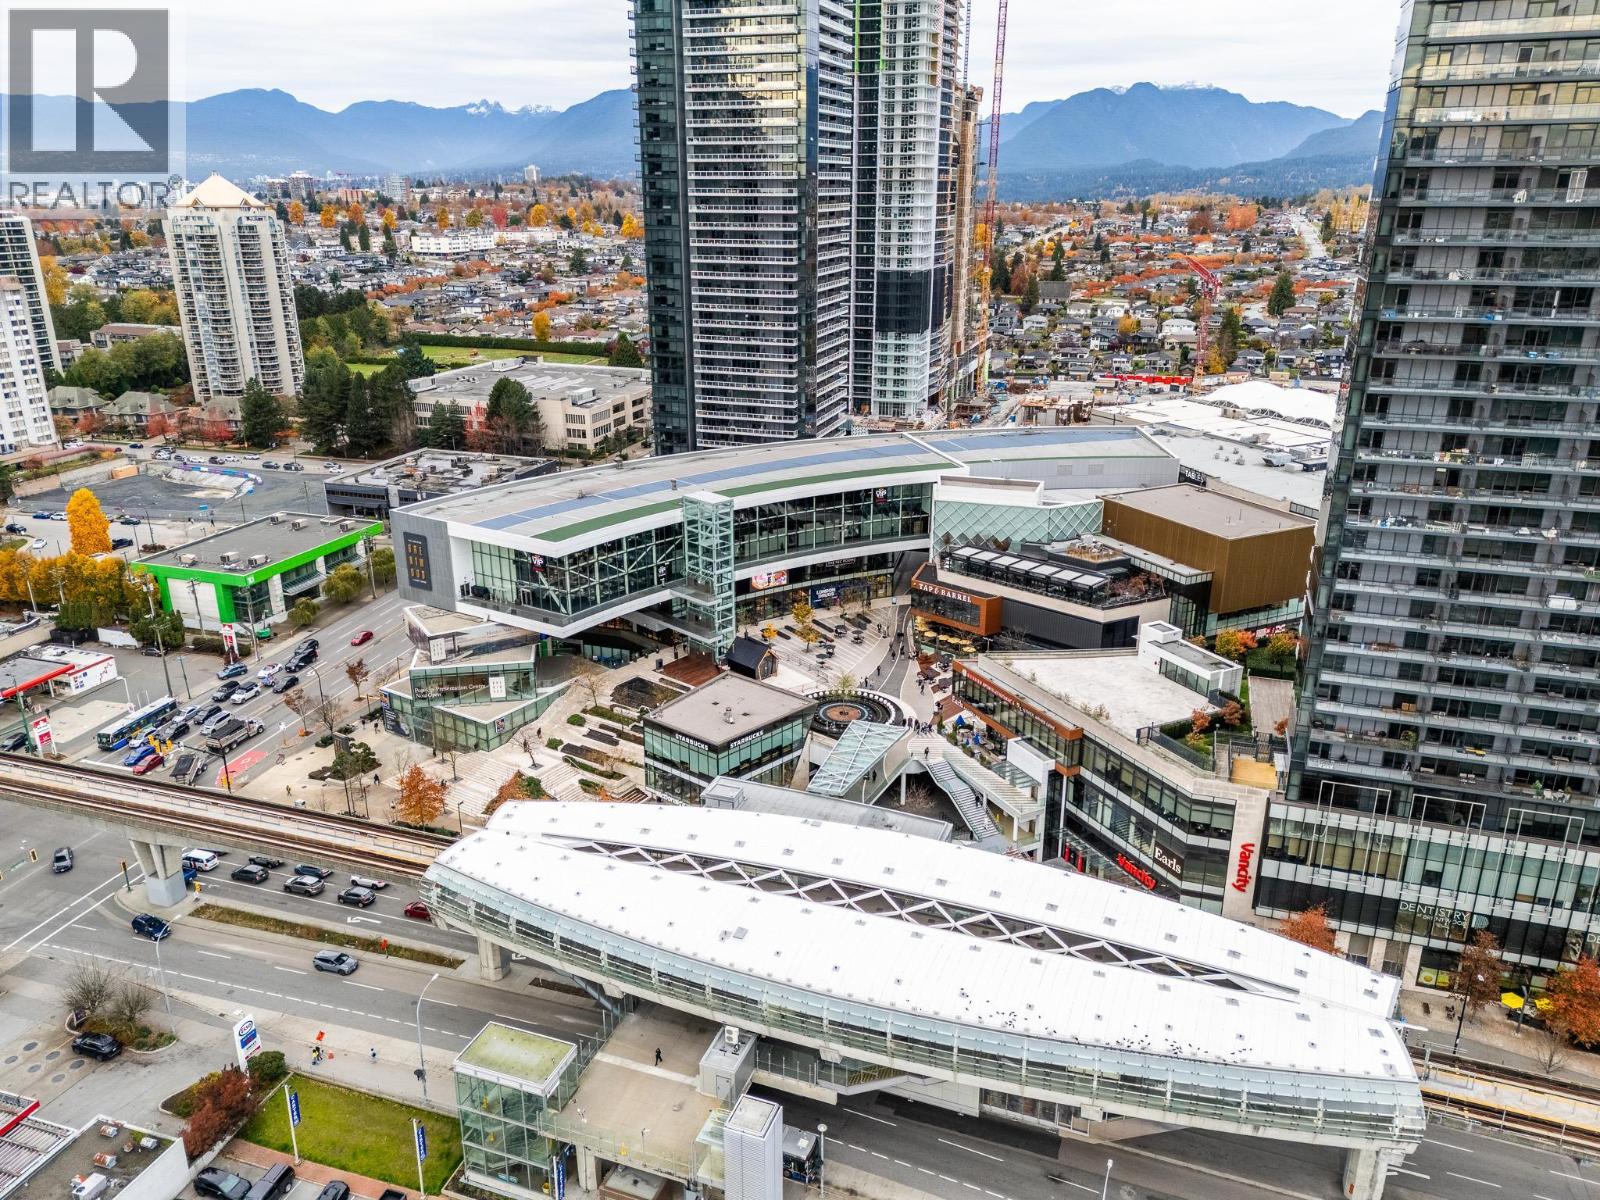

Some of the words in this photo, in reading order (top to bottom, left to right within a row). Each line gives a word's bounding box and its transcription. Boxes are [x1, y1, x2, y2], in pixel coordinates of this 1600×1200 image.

[919, 583, 934, 593] TAP
[941, 589, 972, 603] BARREL
[675, 733, 709, 751] STARBUCKS
[730, 730, 764, 749] STARBUCKS
[1154, 846, 1182, 874] Earls
[1232, 843, 1255, 893] Vancity
[1400, 901, 1470, 921] DENTISTRY
